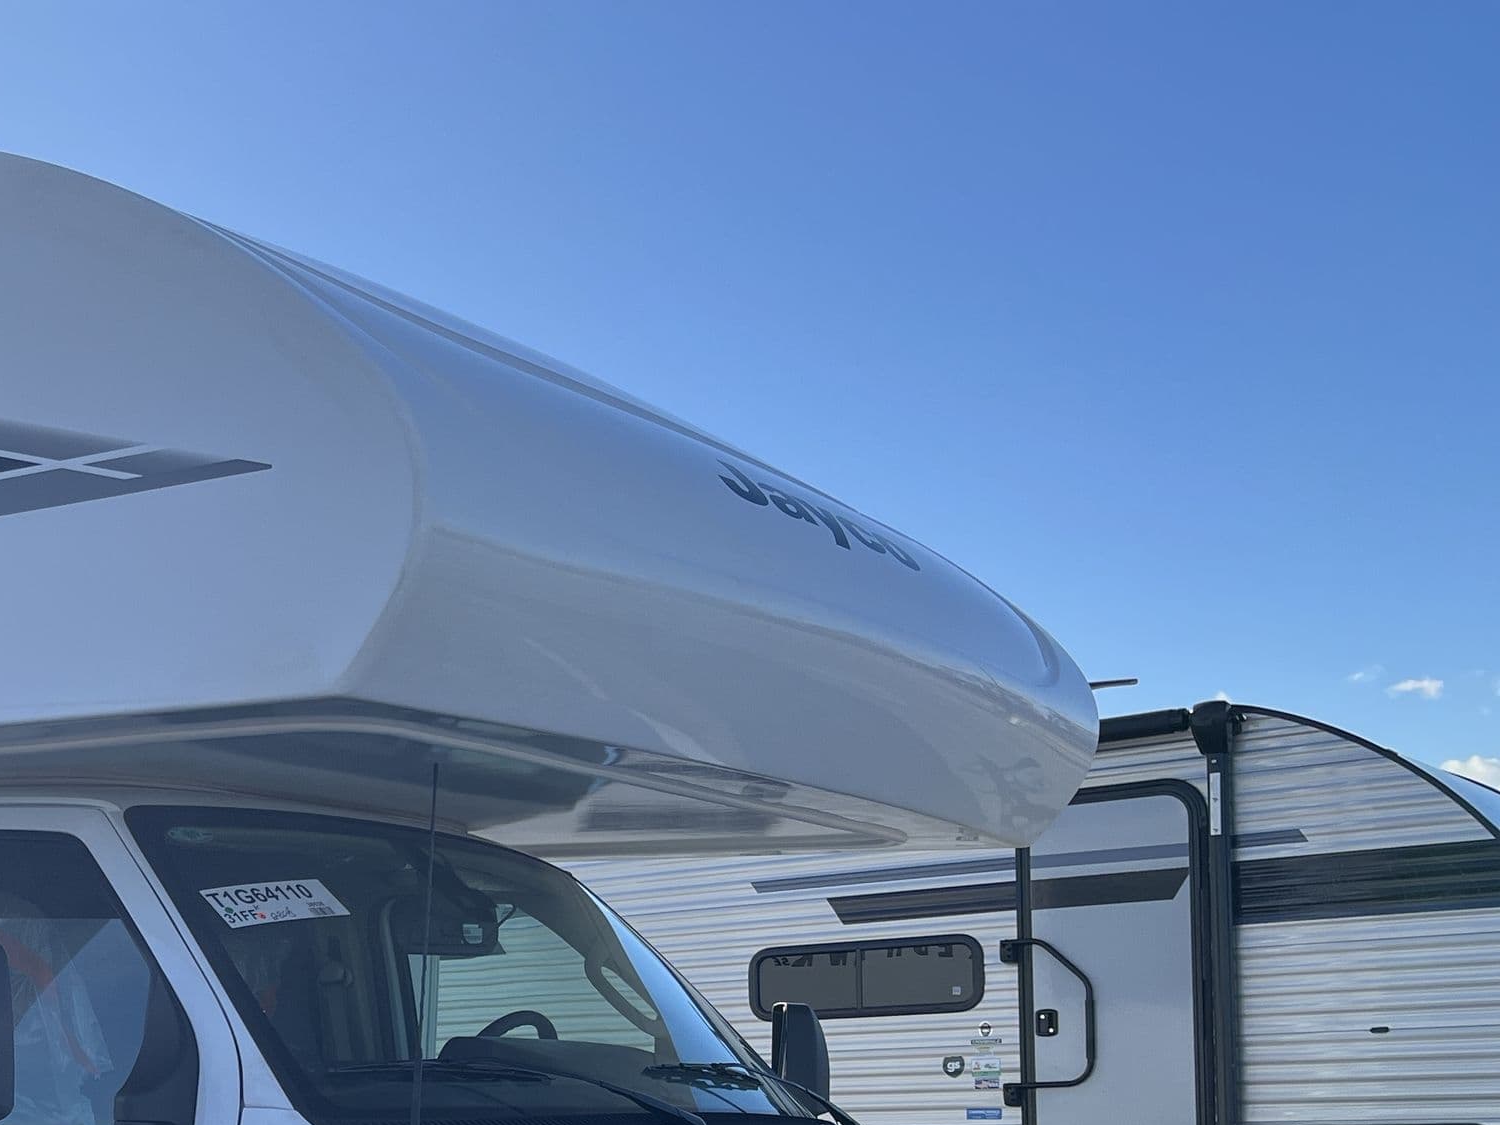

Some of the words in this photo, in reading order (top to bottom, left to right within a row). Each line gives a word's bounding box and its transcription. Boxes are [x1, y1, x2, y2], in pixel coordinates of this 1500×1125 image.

[716, 459, 921, 571] Jayco
[206, 884, 313, 908] T1G64110
[224, 909, 259, 924] 31FF
[946, 1060, 961, 1073] gs
